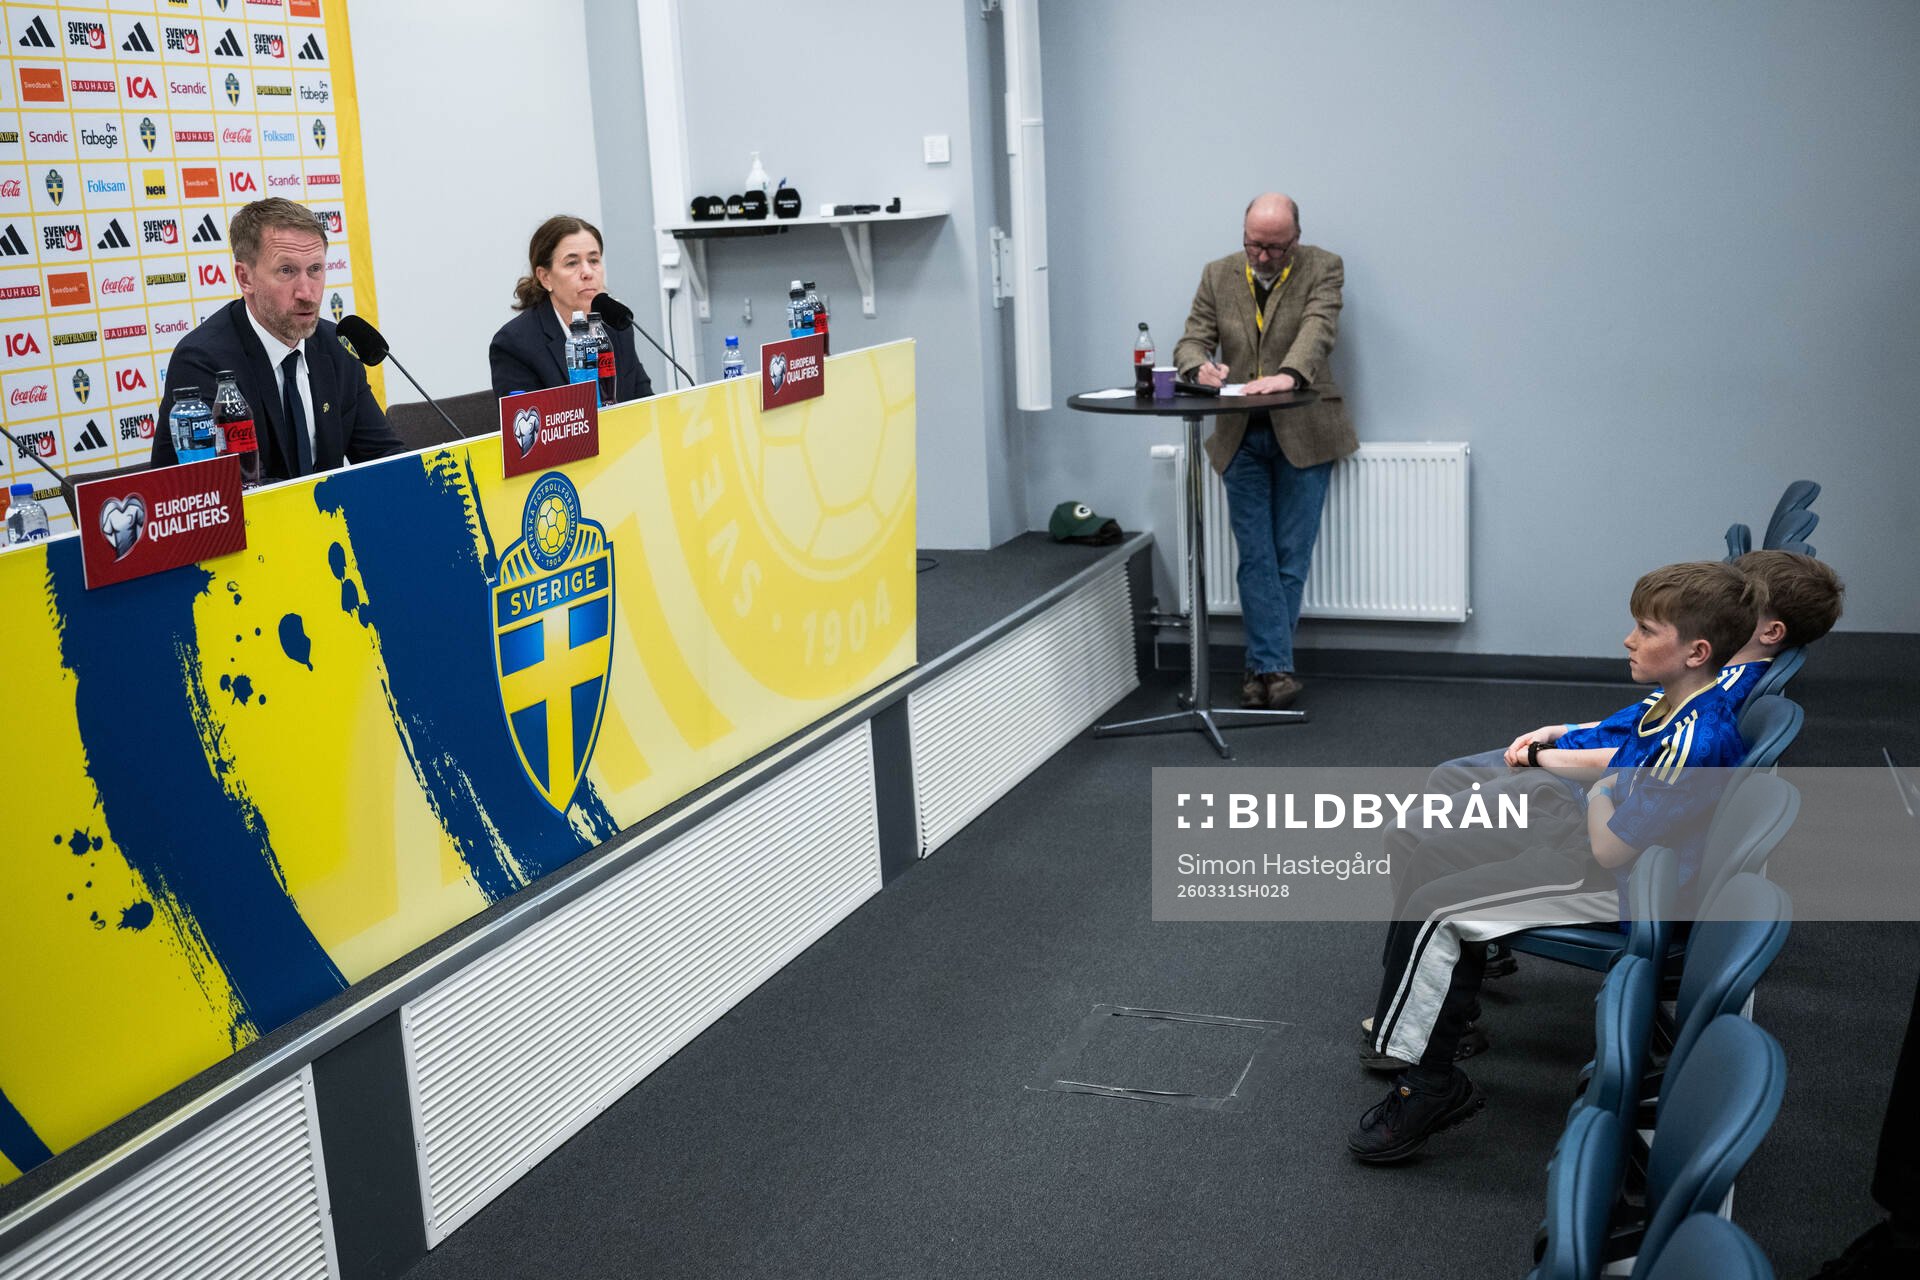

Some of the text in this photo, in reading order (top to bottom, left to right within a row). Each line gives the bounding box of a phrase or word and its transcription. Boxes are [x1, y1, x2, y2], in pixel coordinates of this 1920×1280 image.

[68, 22, 104, 33] SVENSKA
[166, 28, 198, 39] SVENSKA
[70, 35, 89, 46] SPEL
[167, 39, 184, 50] SPEL
[254, 34, 283, 44] SVENSKA
[255, 44, 271, 55] SPEL
[71, 81, 115, 92] BAUHAUS
[126, 76, 157, 98] ICA
[170, 82, 207, 94] Scandic
[300, 86, 329, 103] Fabege
[29, 131, 69, 143] Scandic
[81, 130, 118, 149] Fabege
[175, 132, 214, 142] BAUHAUS
[263, 130, 295, 142] Folksam
[87, 180, 126, 193] Folksam
[230, 171, 257, 192] ICA
[268, 174, 300, 186] Scandic
[307, 175, 340, 185] BAUHAUS
[44, 225, 81, 238] SVENSKA
[143, 219, 177, 231] SVENSKA
[145, 231, 162, 242] SPEL
[45, 237, 65, 250] SPEL
[198, 264, 226, 286] ICA
[0, 286, 40, 298] AUHAUS
[104, 325, 147, 339] BAUHAUS
[155, 319, 189, 334] Scandic
[5, 332, 40, 357] ICA
[790, 355, 815, 370] EUROPEAN
[116, 368, 147, 392] ICA
[786, 365, 819, 385] QUALIFIERS
[120, 414, 154, 429] SVENSKA
[545, 408, 585, 427] EUROPEAN
[121, 429, 139, 440] SPEL
[540, 420, 590, 445] QUALIFIERS
[154, 490, 220, 518] EUROPEAN
[148, 506, 230, 542] QUALIFIERS
[546, 557, 562, 567] 1904
[510, 566, 596, 616] SVERIGE
[804, 579, 891, 668] 1904
